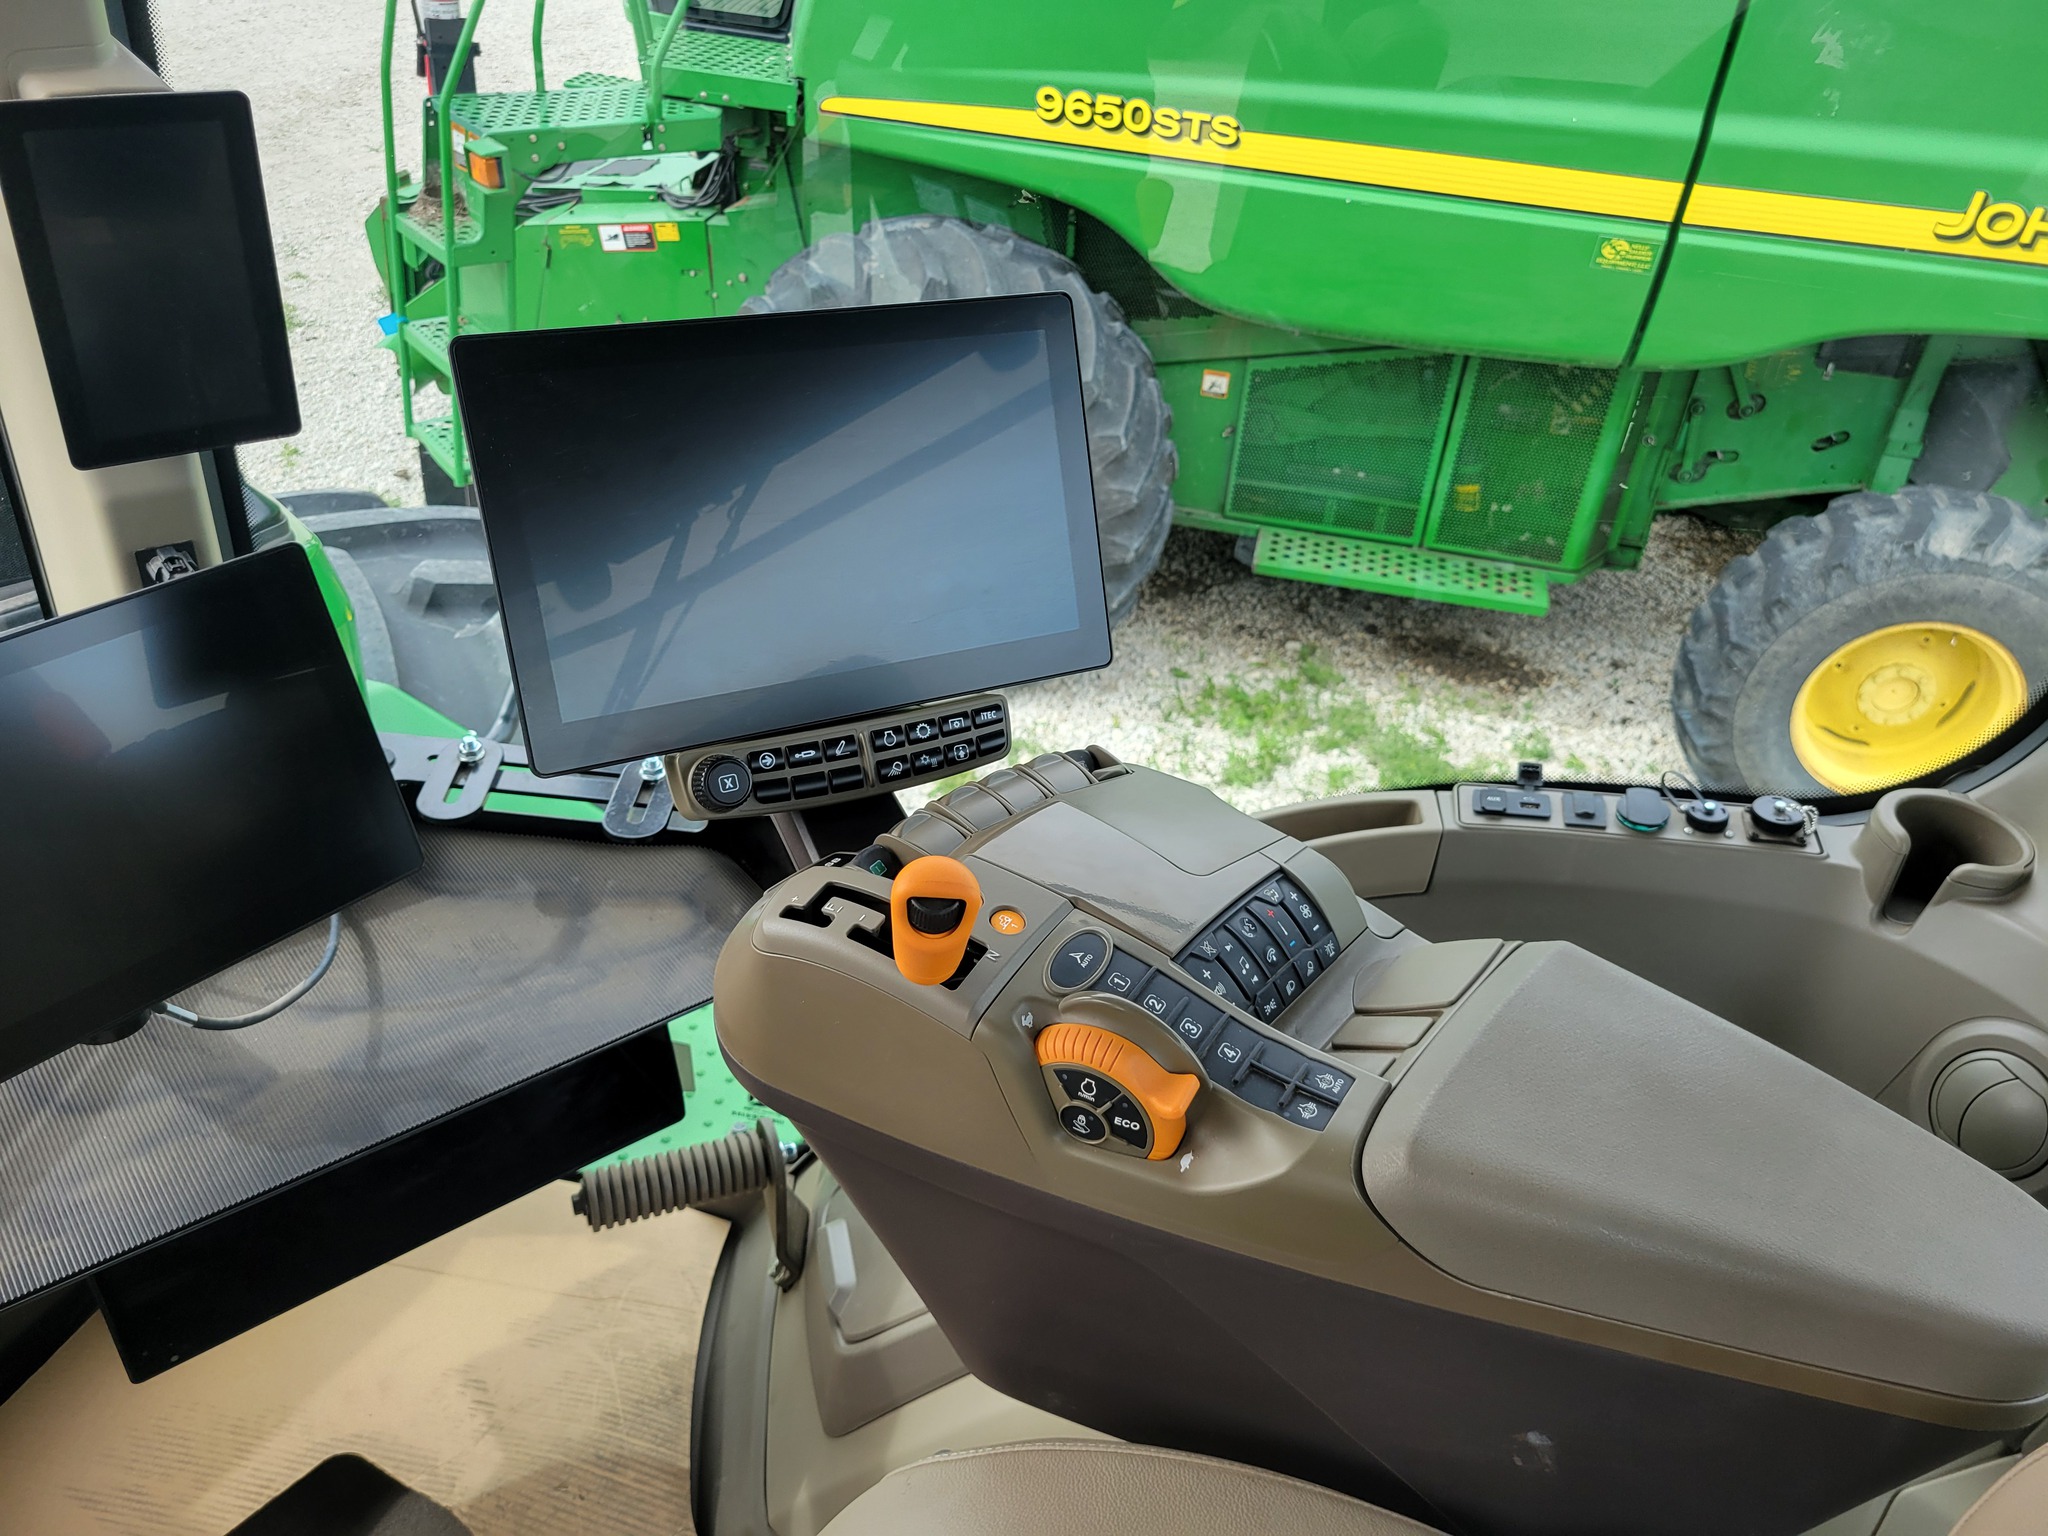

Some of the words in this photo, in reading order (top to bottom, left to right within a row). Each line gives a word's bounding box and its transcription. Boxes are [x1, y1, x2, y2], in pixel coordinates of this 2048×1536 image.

[1035, 86, 1241, 146] 9650STS
[980, 710, 997, 721] iTEC
[723, 777, 734, 789] X
[824, 902, 835, 911] F
[986, 949, 1000, 961] N
[1080, 953, 1094, 968] AUTO
[1113, 976, 1126, 986] 1
[1148, 998, 1162, 1010] 2
[1184, 1022, 1198, 1034] 3
[1223, 1047, 1237, 1058] 4
[1332, 1078, 1344, 1094] AUTO
[1114, 1116, 1140, 1130] ECO
